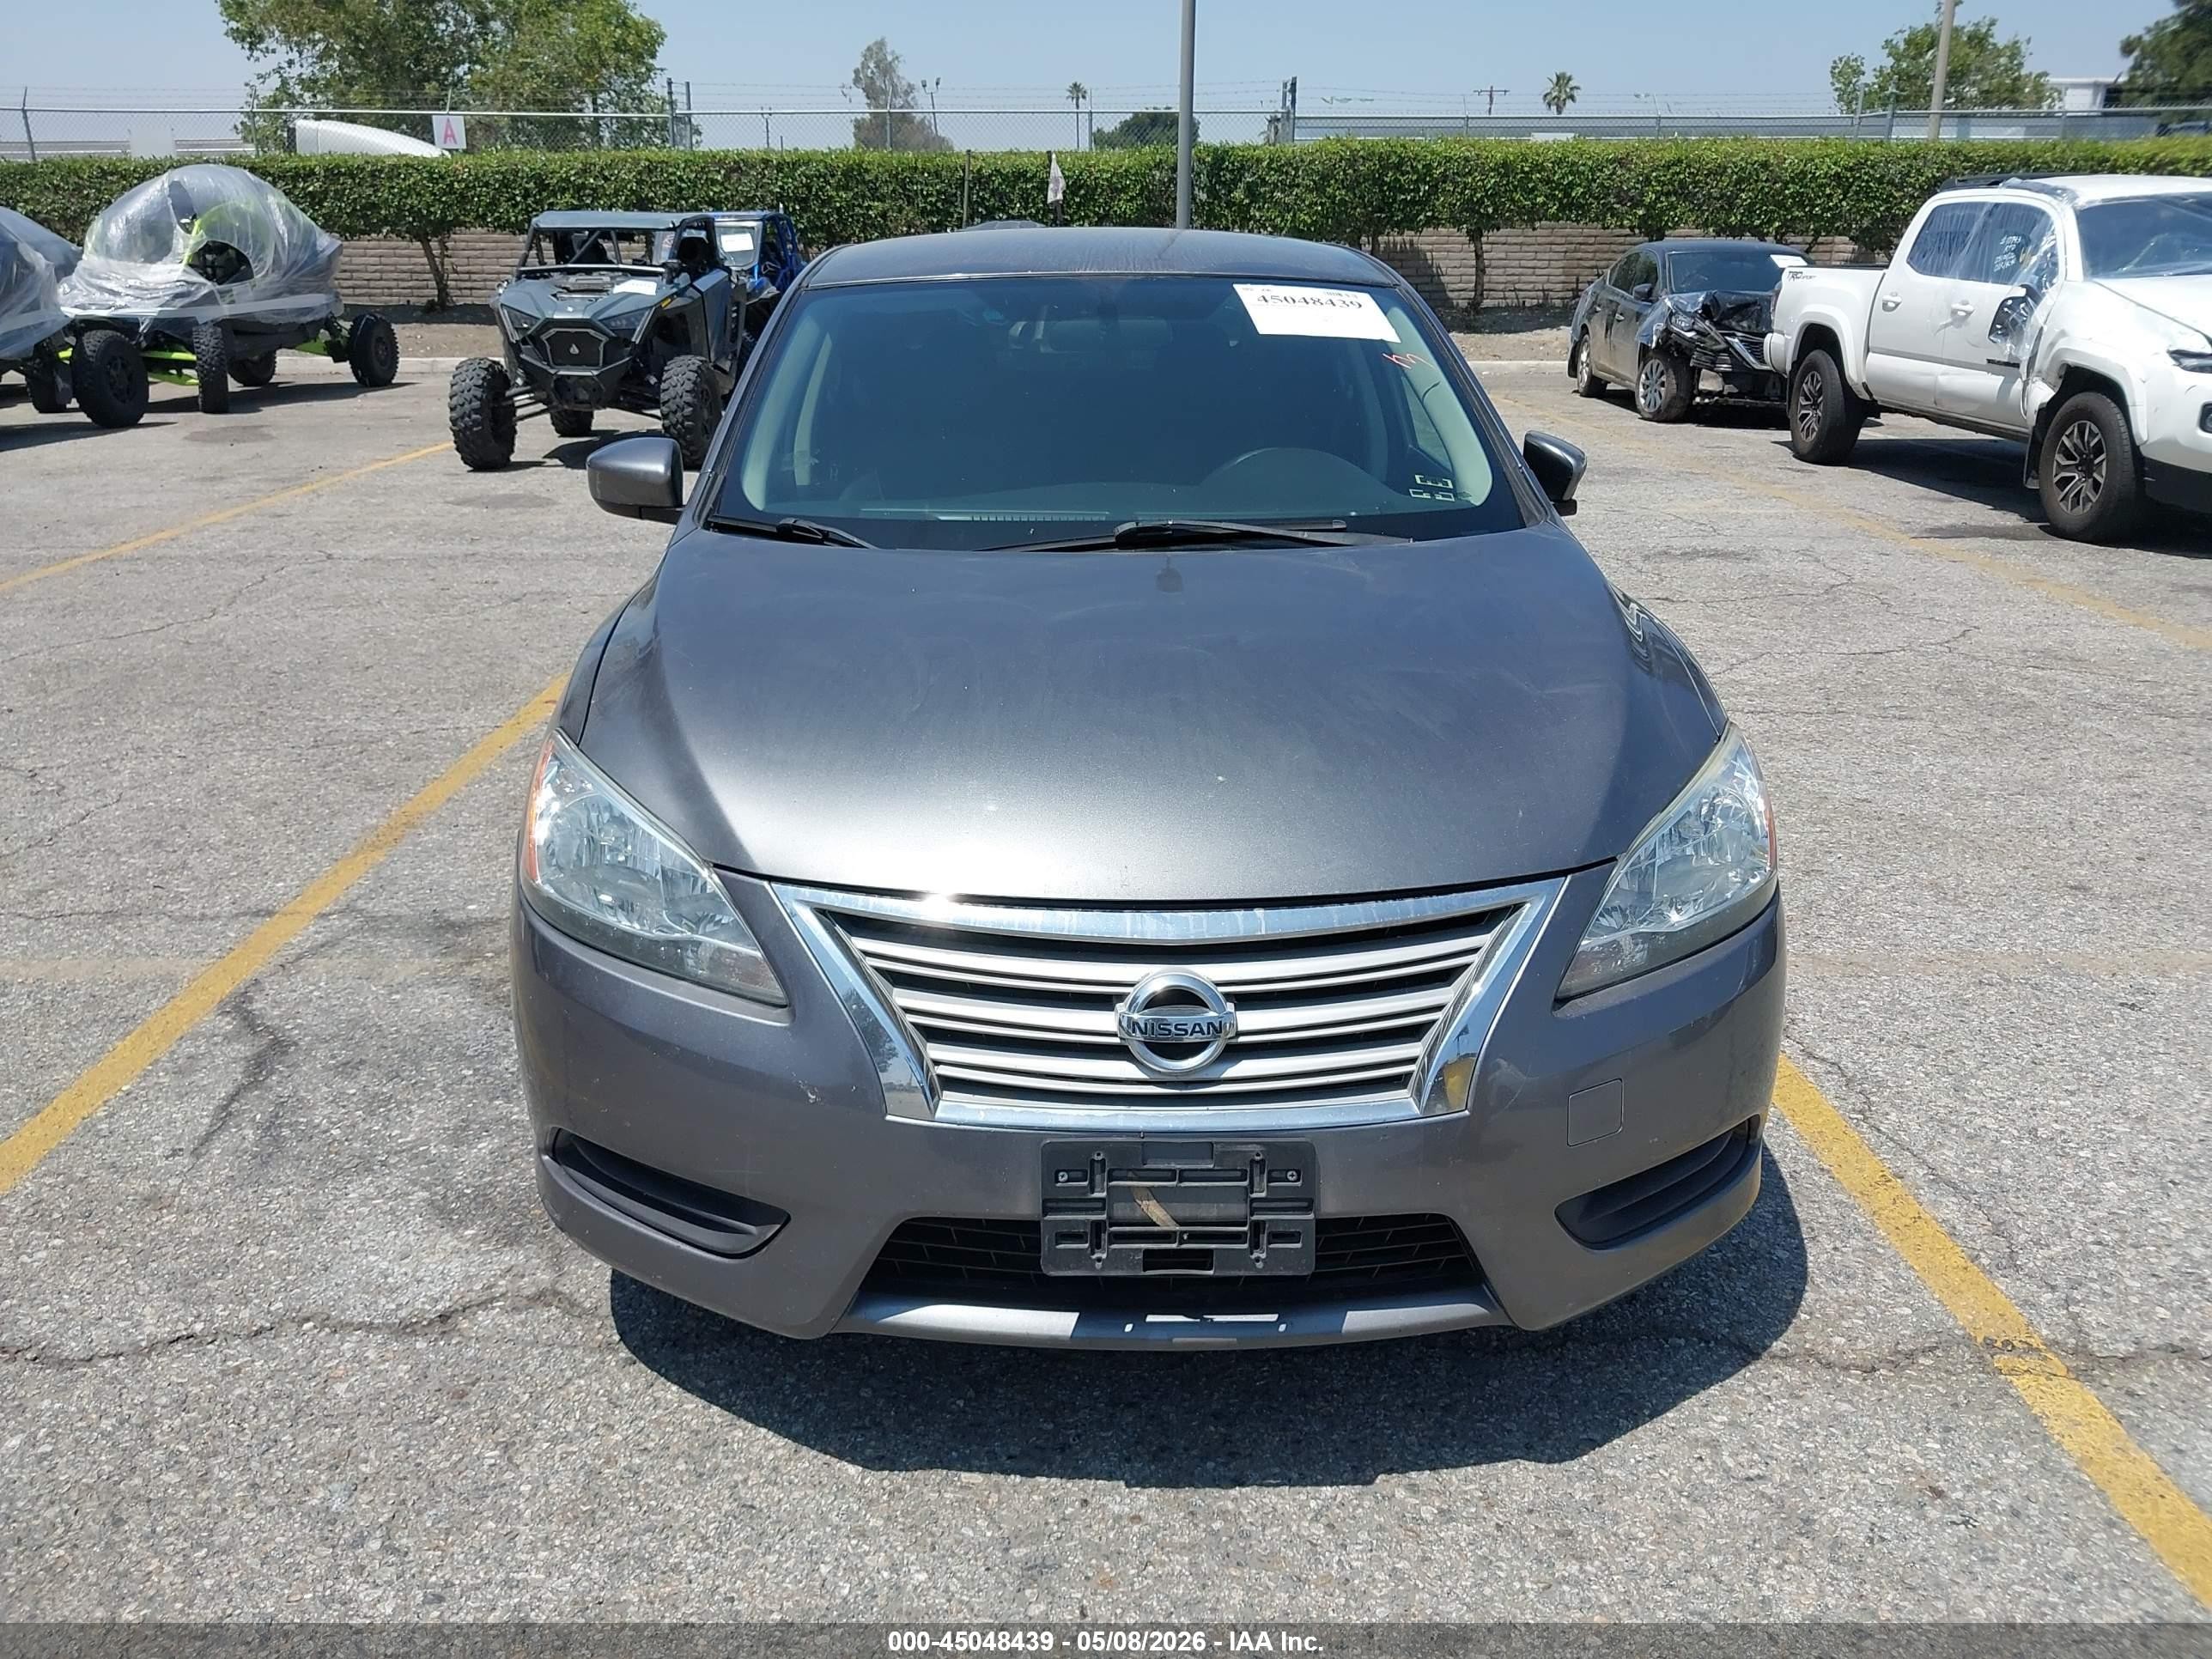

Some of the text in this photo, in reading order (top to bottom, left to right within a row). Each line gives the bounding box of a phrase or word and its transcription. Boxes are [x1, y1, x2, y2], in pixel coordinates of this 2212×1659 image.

[443, 117, 458, 145] A
[1257, 295, 1363, 309] 45048439
[1131, 1020, 1223, 1036] NISSAN
